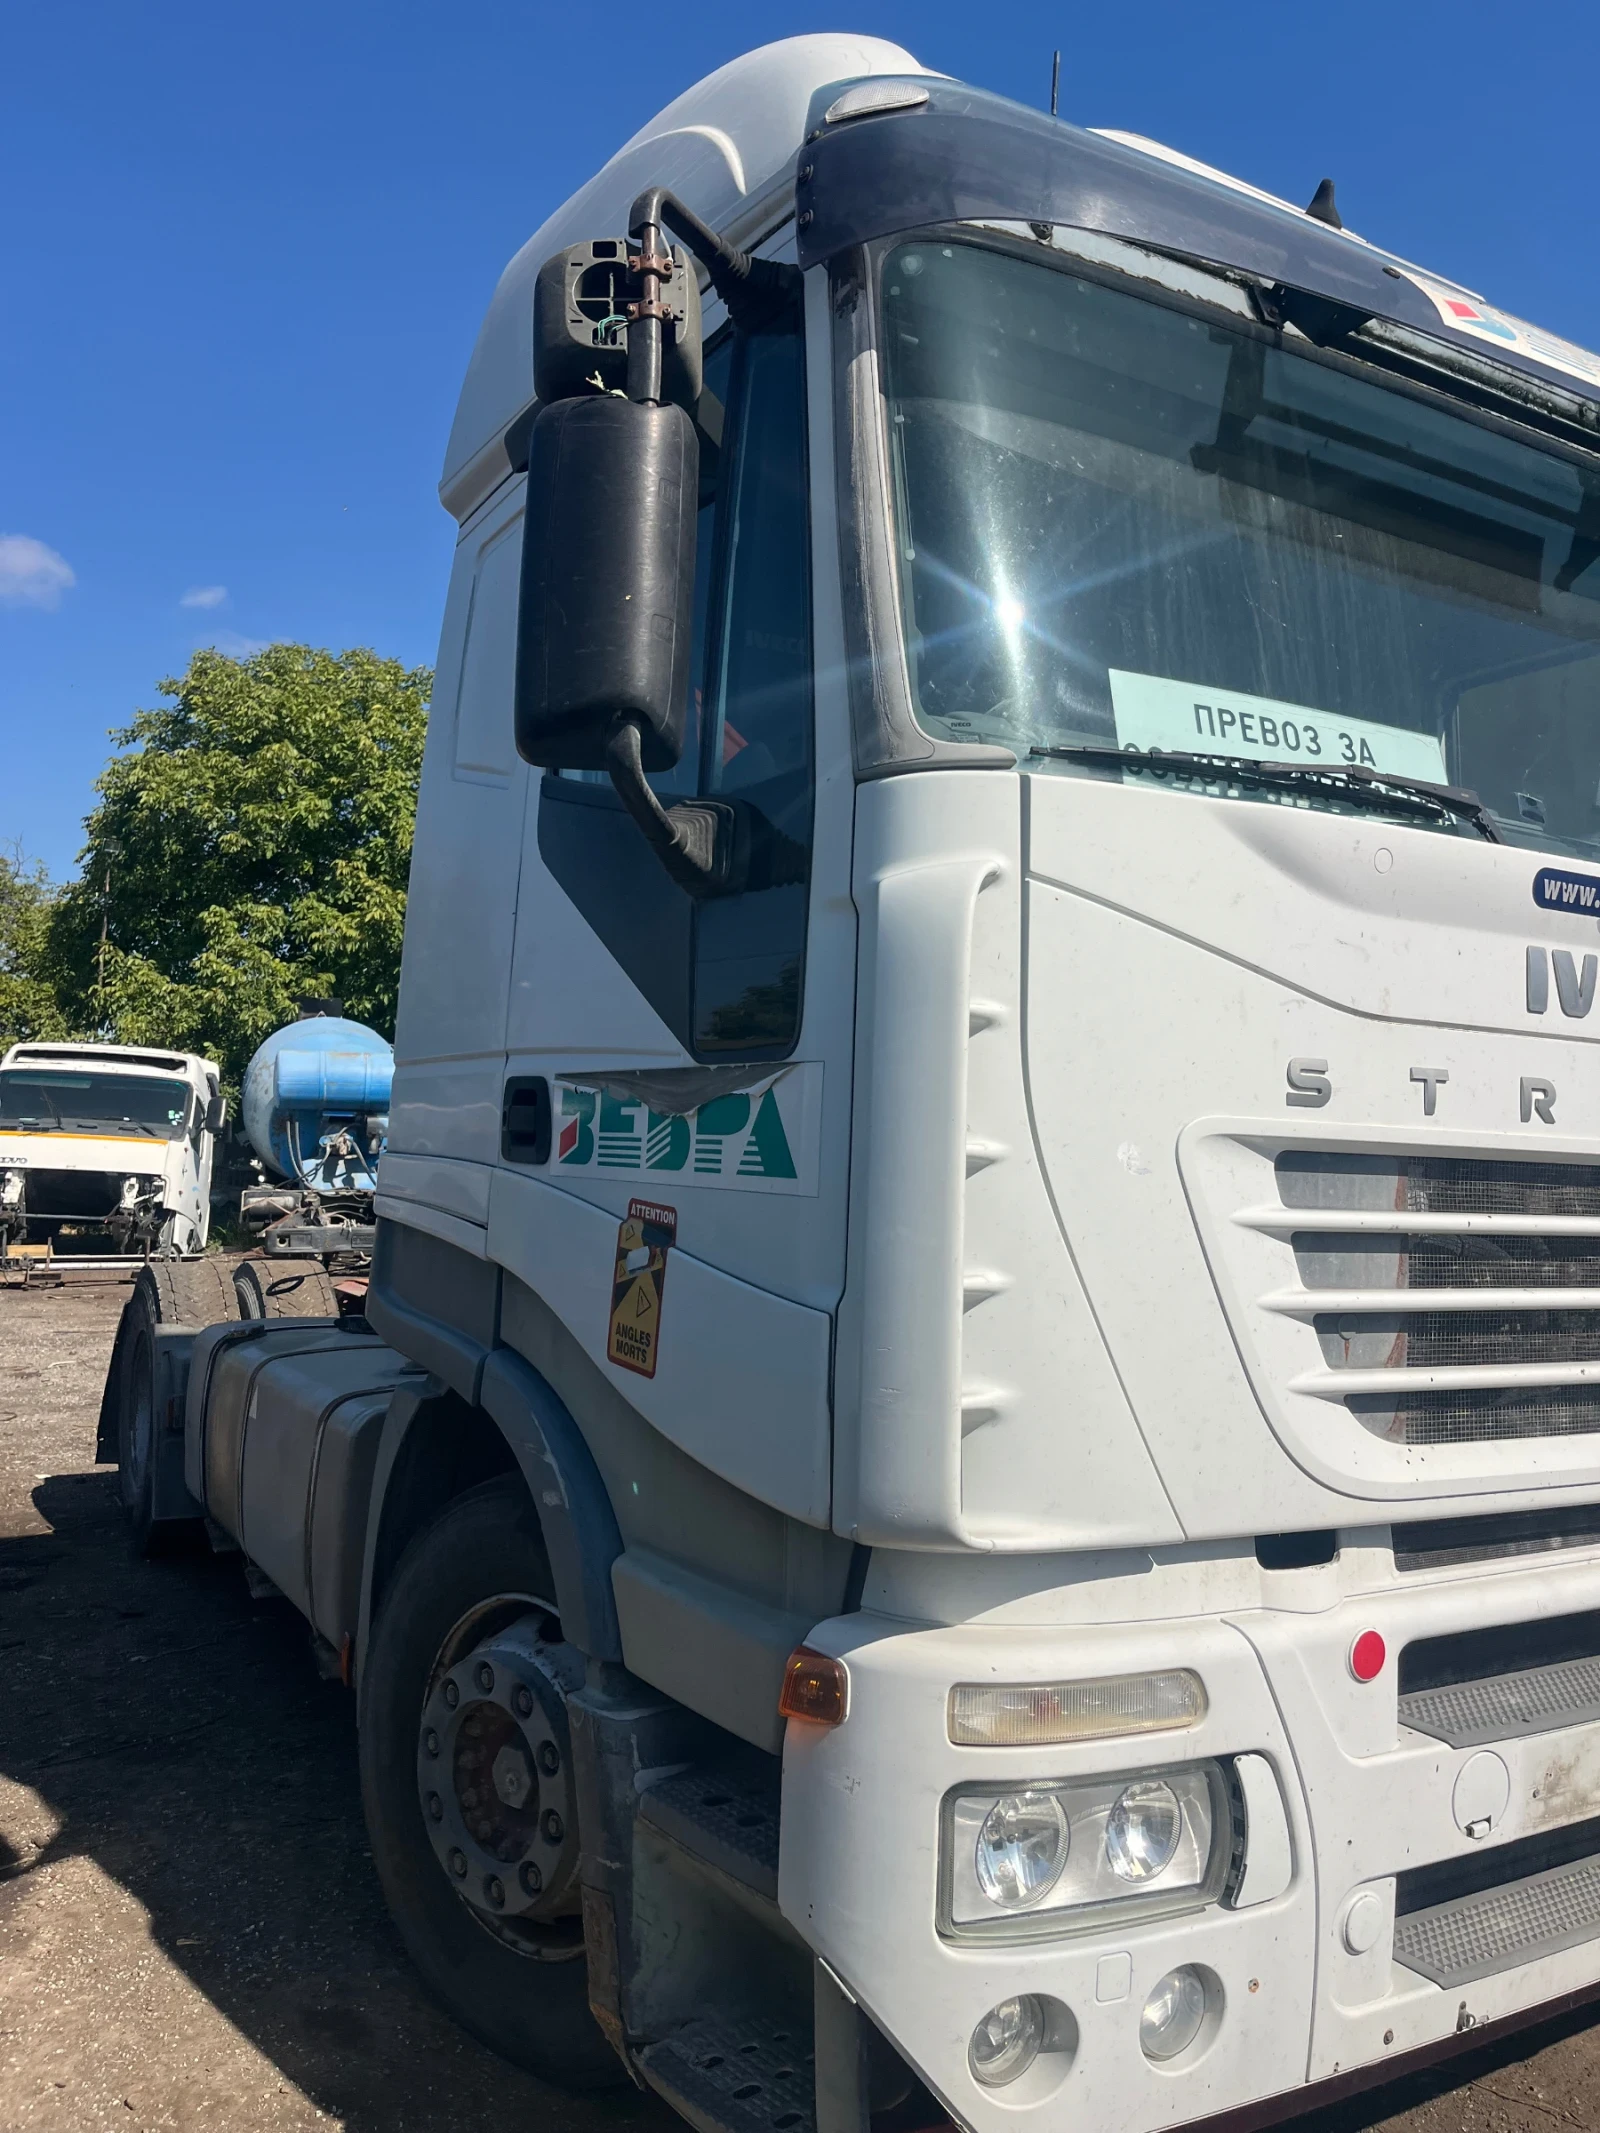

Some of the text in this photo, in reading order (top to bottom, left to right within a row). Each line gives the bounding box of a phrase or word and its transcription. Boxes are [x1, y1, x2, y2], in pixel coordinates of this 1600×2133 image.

[1193, 703, 1377, 767] ПРЕВОЗ ЗА
[630, 1202, 675, 1225] ATTENTION
[616, 1322, 652, 1348] ANGLES
[616, 1338, 647, 1364] MORTS
